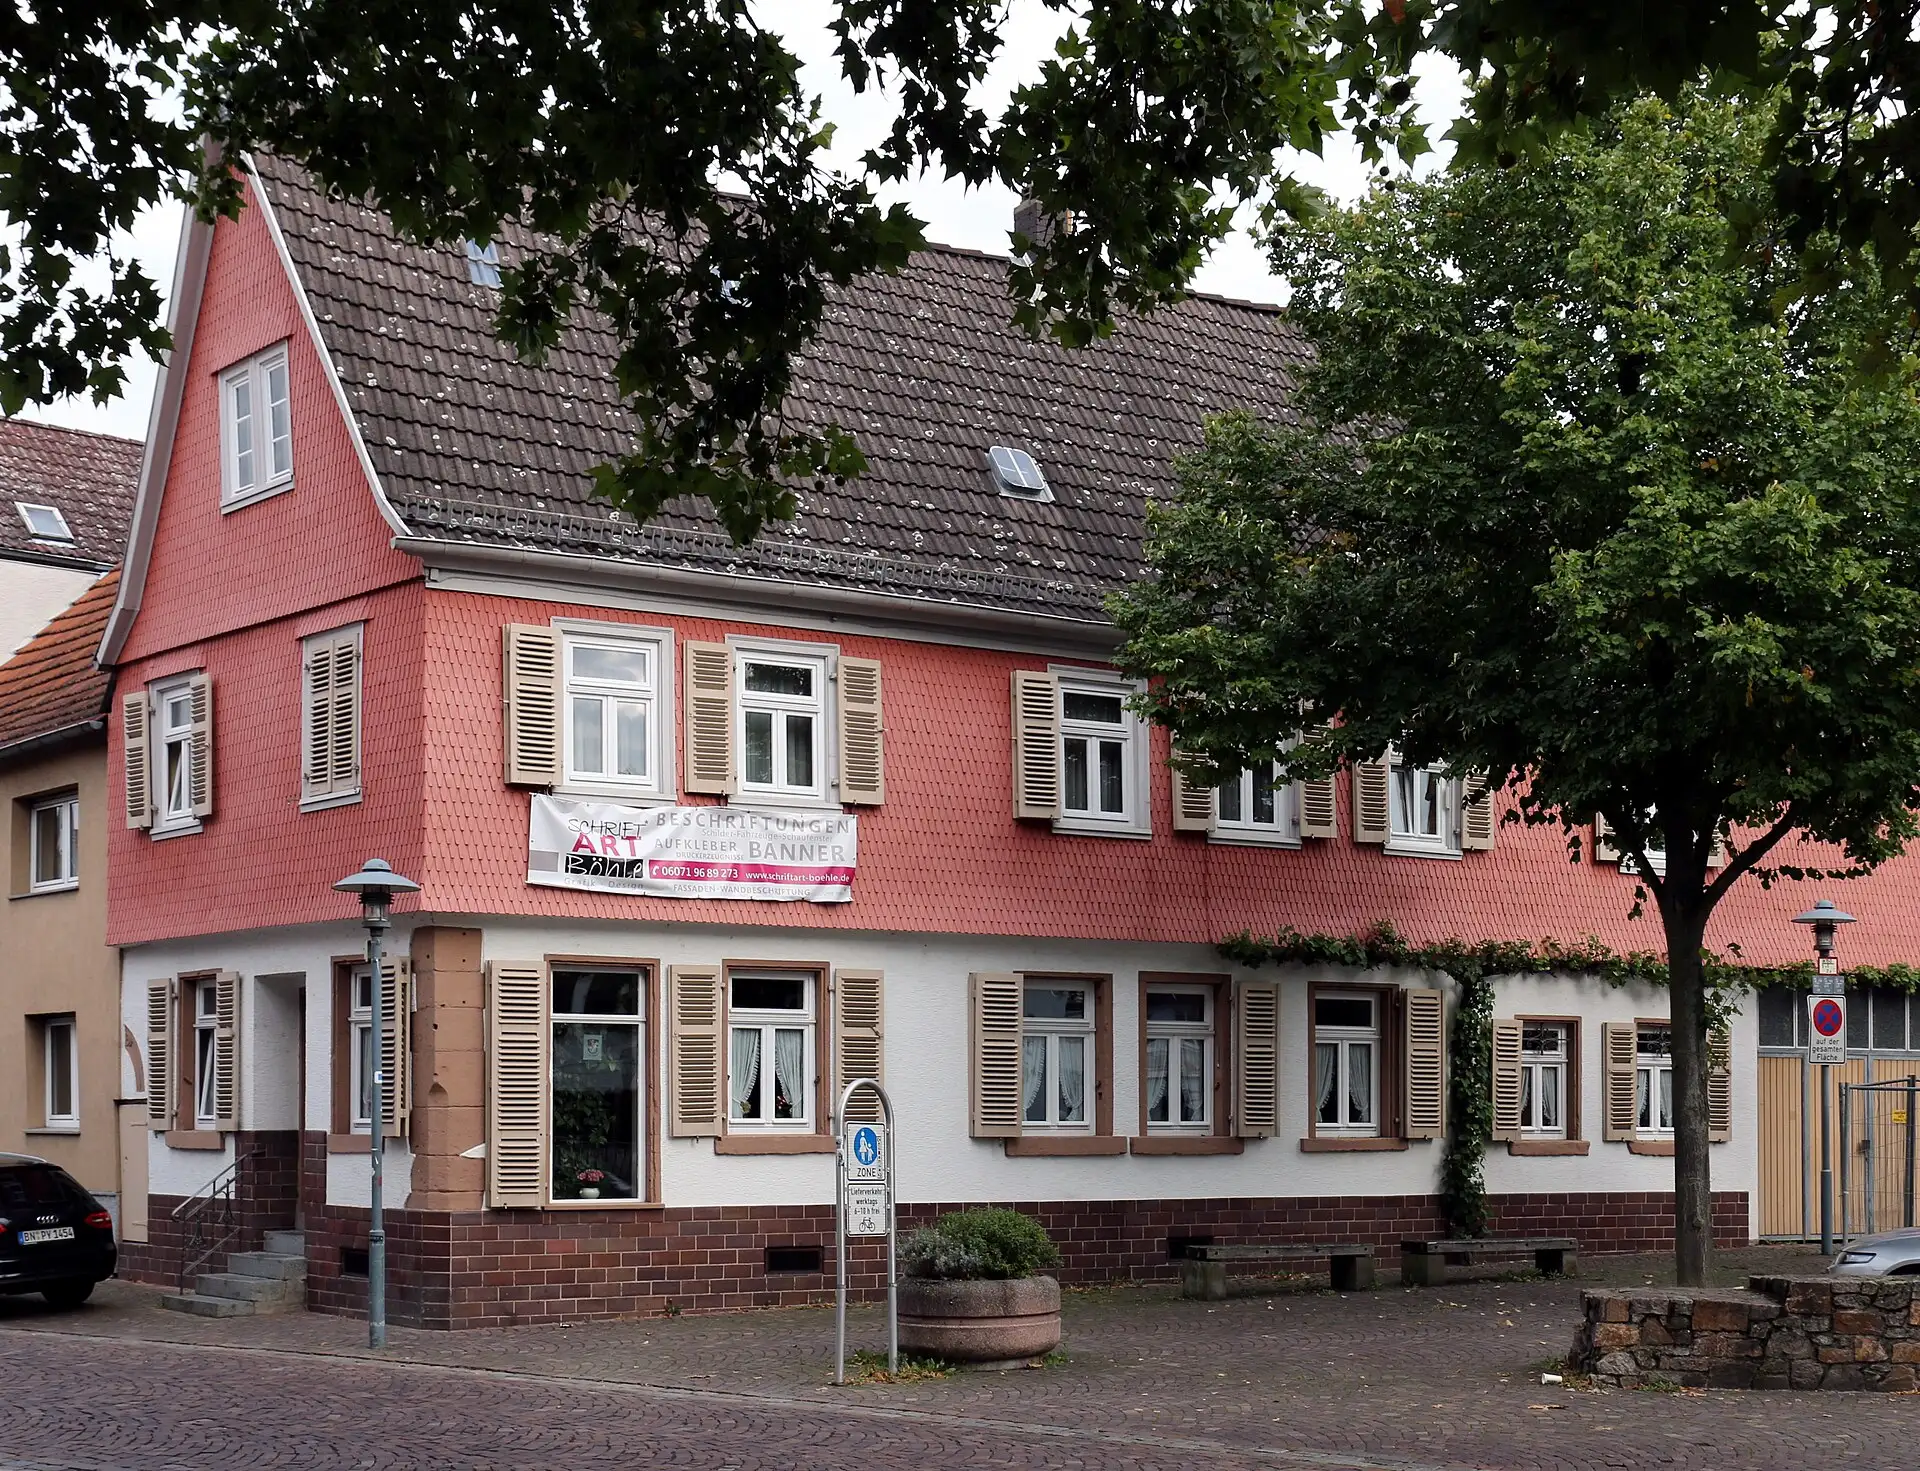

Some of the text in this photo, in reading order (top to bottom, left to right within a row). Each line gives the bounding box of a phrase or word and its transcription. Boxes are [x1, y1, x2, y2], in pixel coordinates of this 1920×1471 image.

[568, 818, 646, 837] SCHRIFT
[656, 812, 850, 834] BESCHRIFTUNGEN
[572, 832, 641, 857] ART
[654, 838, 737, 852] AUFKLEBER
[749, 841, 846, 862] BANNER
[676, 852, 745, 861] DRUCKERZEUGNISSE
[566, 854, 643, 879] Böhle
[661, 866, 850, 883] 06071 96 89 273 www.schriftart-boehle.de
[564, 877, 644, 891] Grafik Design
[1812, 1046, 1843, 1054] gesamten
[1816, 1053, 1838, 1061] Fläche
[857, 1167, 876, 1178] ZONE
[850, 1187, 882, 1196] Lieferverkehr
[855, 1198, 878, 1206] werktags
[24, 1232, 36, 1241] BN
[53, 1228, 73, 1239] 1454
